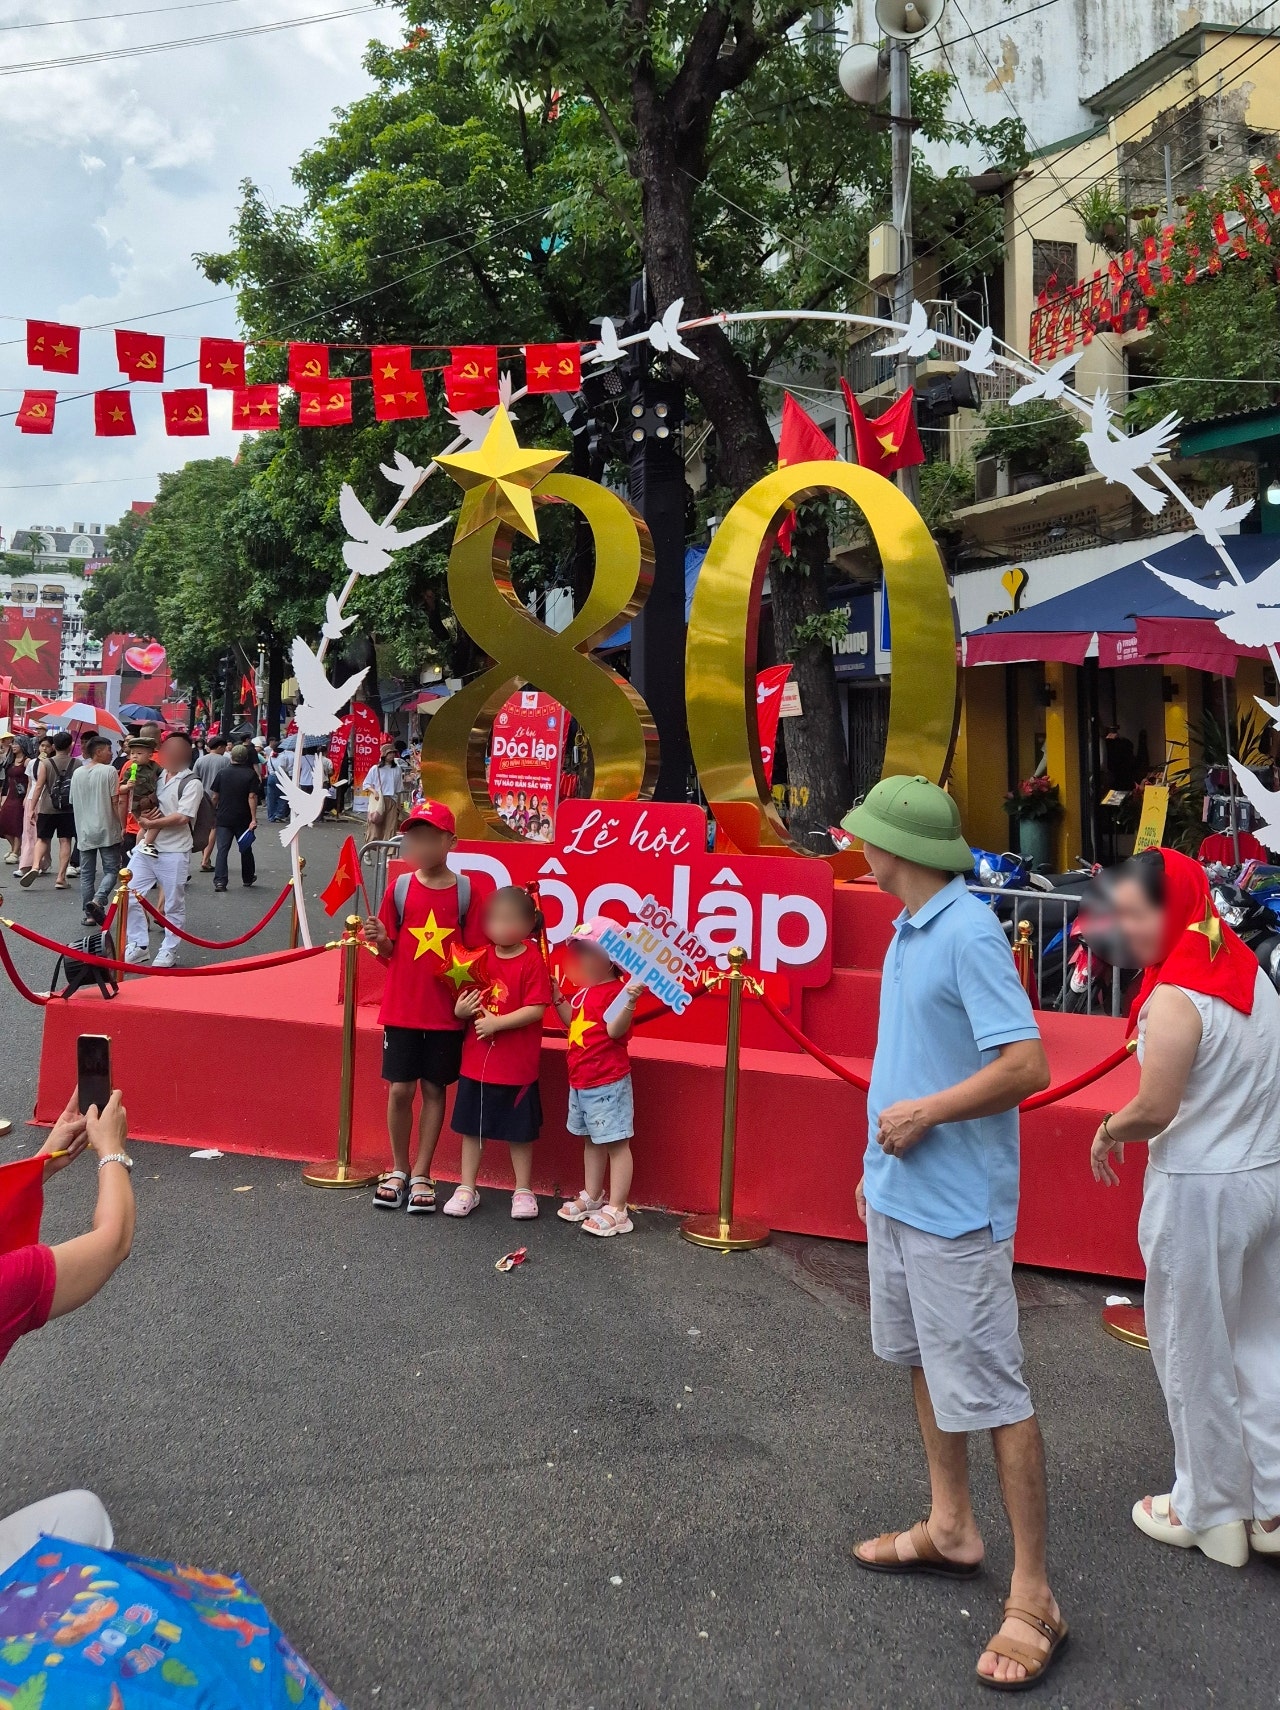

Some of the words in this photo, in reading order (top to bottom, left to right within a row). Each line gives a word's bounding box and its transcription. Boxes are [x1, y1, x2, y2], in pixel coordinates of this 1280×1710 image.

[421, 460, 958, 857] 80
[355, 733, 379, 745] Độc
[493, 736, 529, 760] Độc
[531, 738, 557, 761] lập
[563, 809, 620, 855] Lễ
[629, 810, 690, 858] hội
[639, 903, 678, 938] ĐỘC
[673, 930, 707, 960] LẬP
[672, 864, 828, 974] lập
[599, 929, 648, 976] HẠNH
[643, 966, 691, 1013] PHÚC
[635, 926, 662, 954] TỰ
[656, 946, 684, 975] DO
